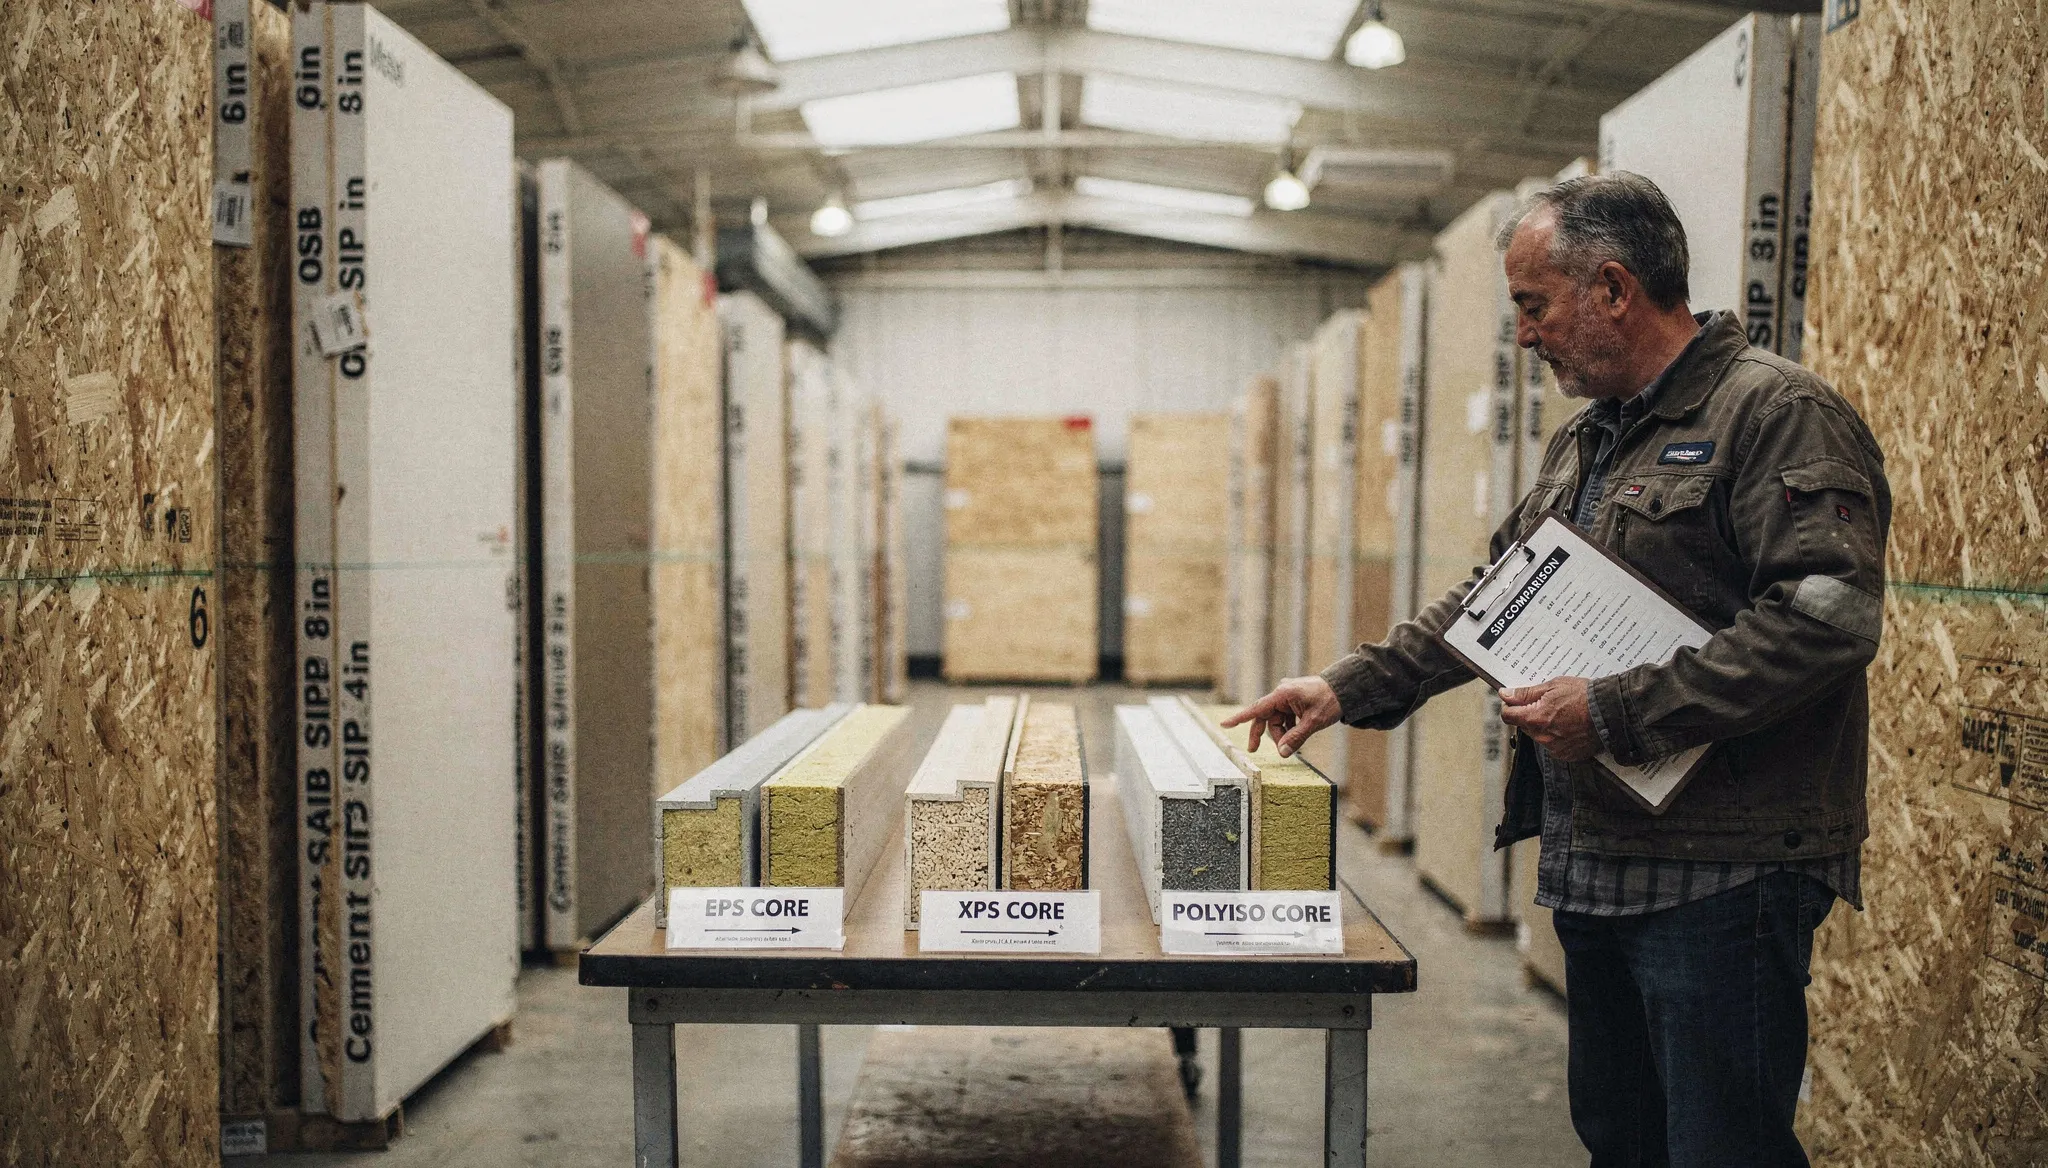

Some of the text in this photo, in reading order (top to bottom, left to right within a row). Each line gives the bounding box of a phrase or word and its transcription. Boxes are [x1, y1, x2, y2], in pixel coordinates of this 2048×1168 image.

[298, 206, 323, 285] OSB
[339, 229, 365, 290] SIP
[190, 585, 208, 648] 6
[1490, 557, 1560, 636] SIP COMPARISON
[343, 719, 369, 784] SIP
[705, 898, 809, 917] EPS CORE
[958, 901, 1065, 920] XPS CORE
[1172, 903, 1331, 923] POLYISO CORE
[343, 891, 372, 1064] Cement
